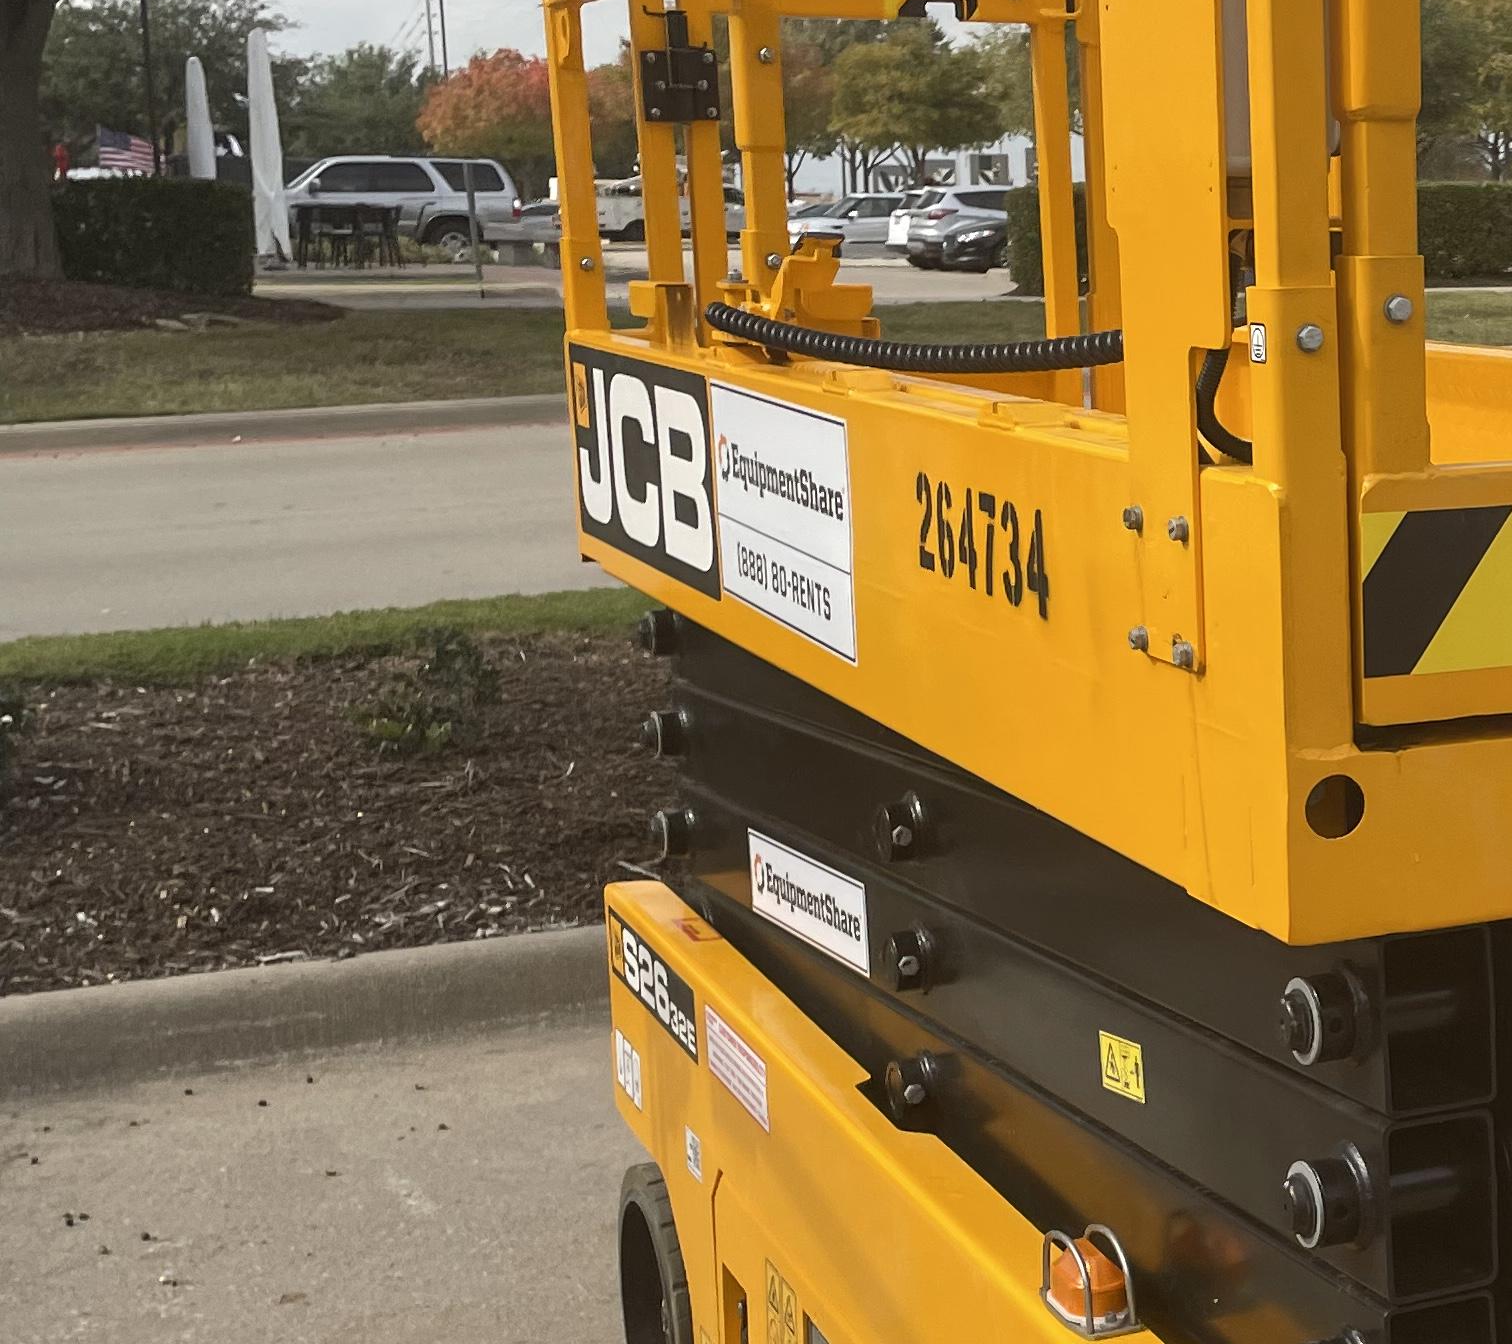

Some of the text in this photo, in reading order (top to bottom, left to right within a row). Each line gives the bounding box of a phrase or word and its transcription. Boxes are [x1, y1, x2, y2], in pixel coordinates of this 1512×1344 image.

[579, 367, 713, 573] JCB
[730, 443, 844, 521] EquipmentShare
[737, 541, 831, 622] (888) 80-RENTS
[915, 471, 1050, 621] 264734
[765, 862, 861, 942] EquipmentShare
